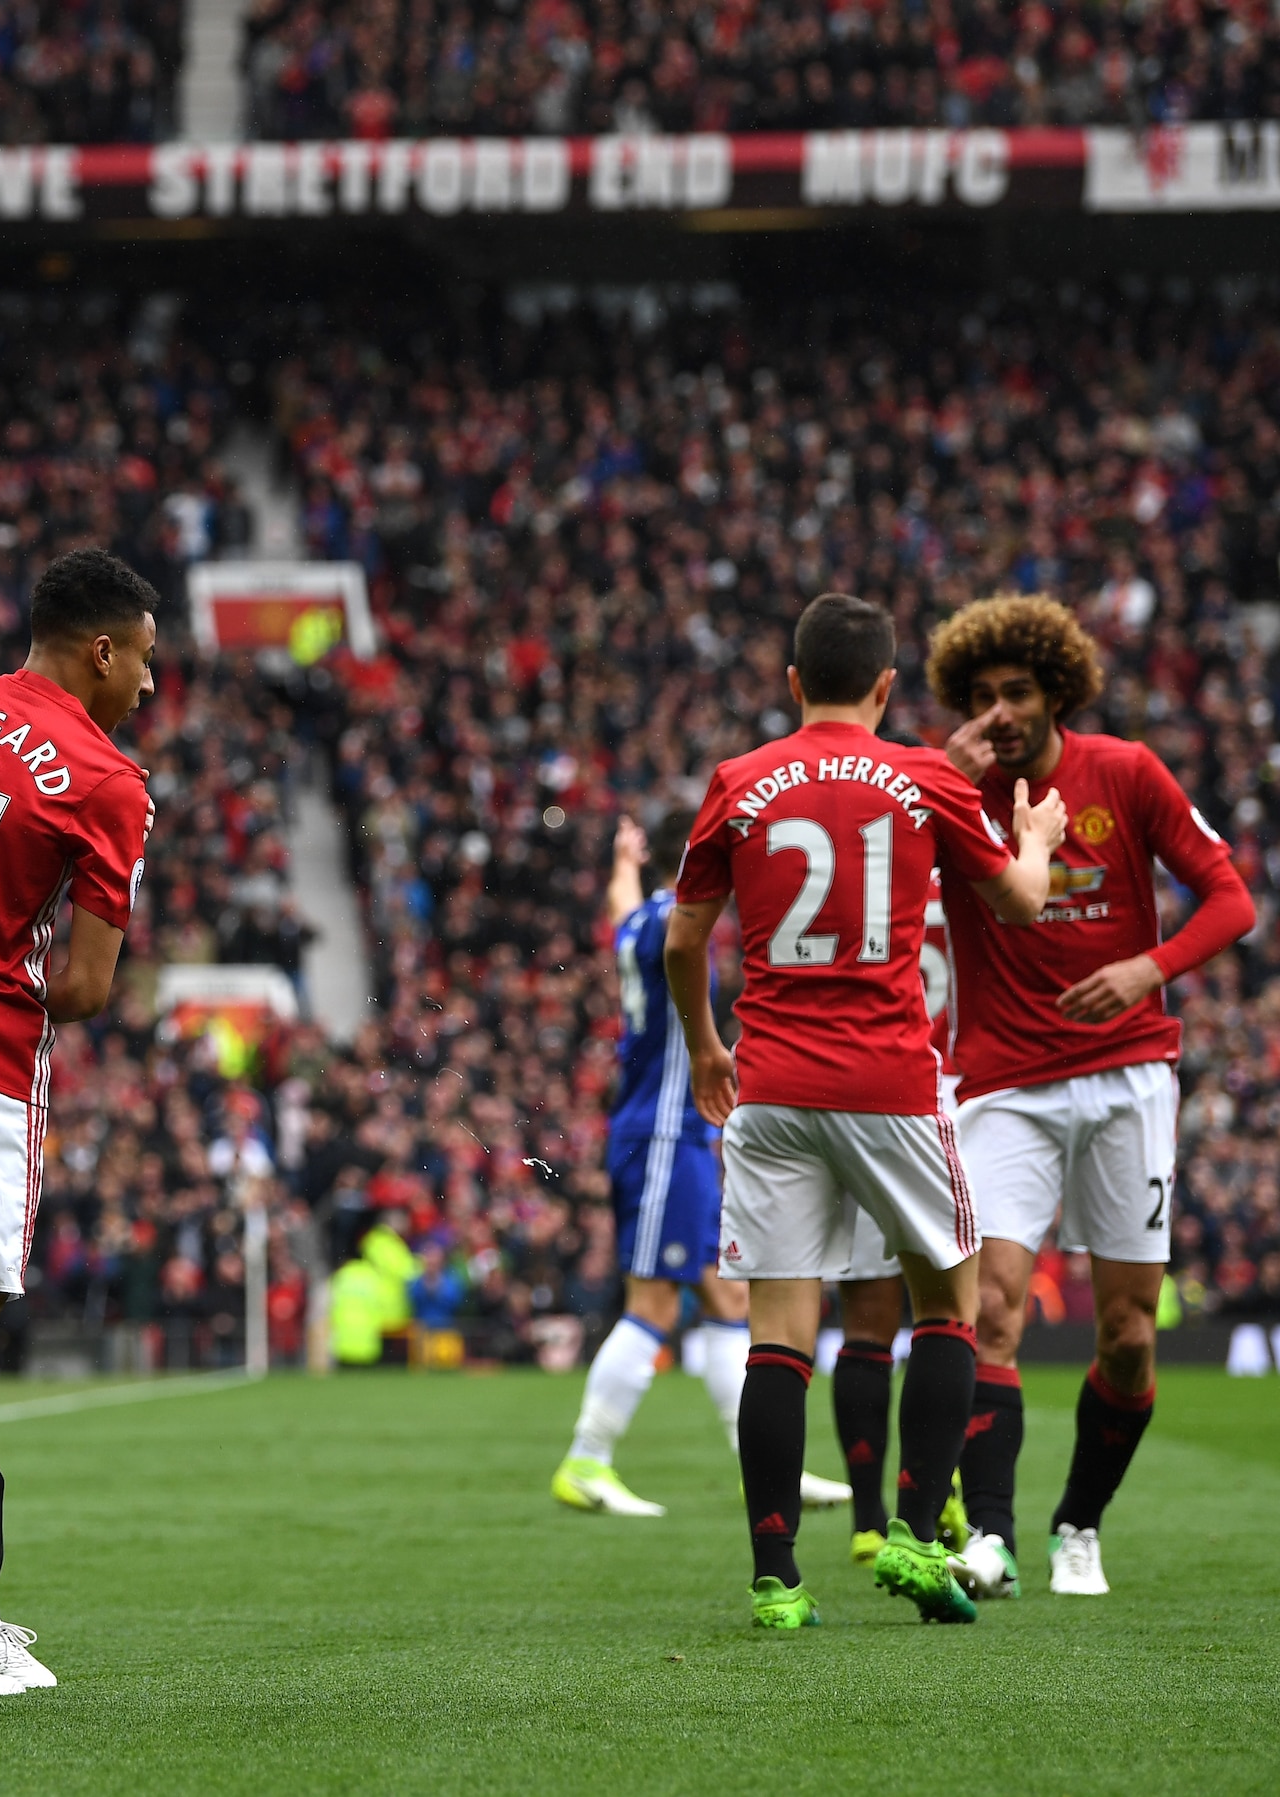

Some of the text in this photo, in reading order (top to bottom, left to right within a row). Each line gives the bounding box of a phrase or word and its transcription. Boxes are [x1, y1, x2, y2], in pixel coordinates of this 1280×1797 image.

[150, 138, 569, 219] STRETFORD
[802, 127, 1010, 208] MUFC
[728, 755, 934, 839] ANDER HERRERA
[766, 812, 894, 967] 21
